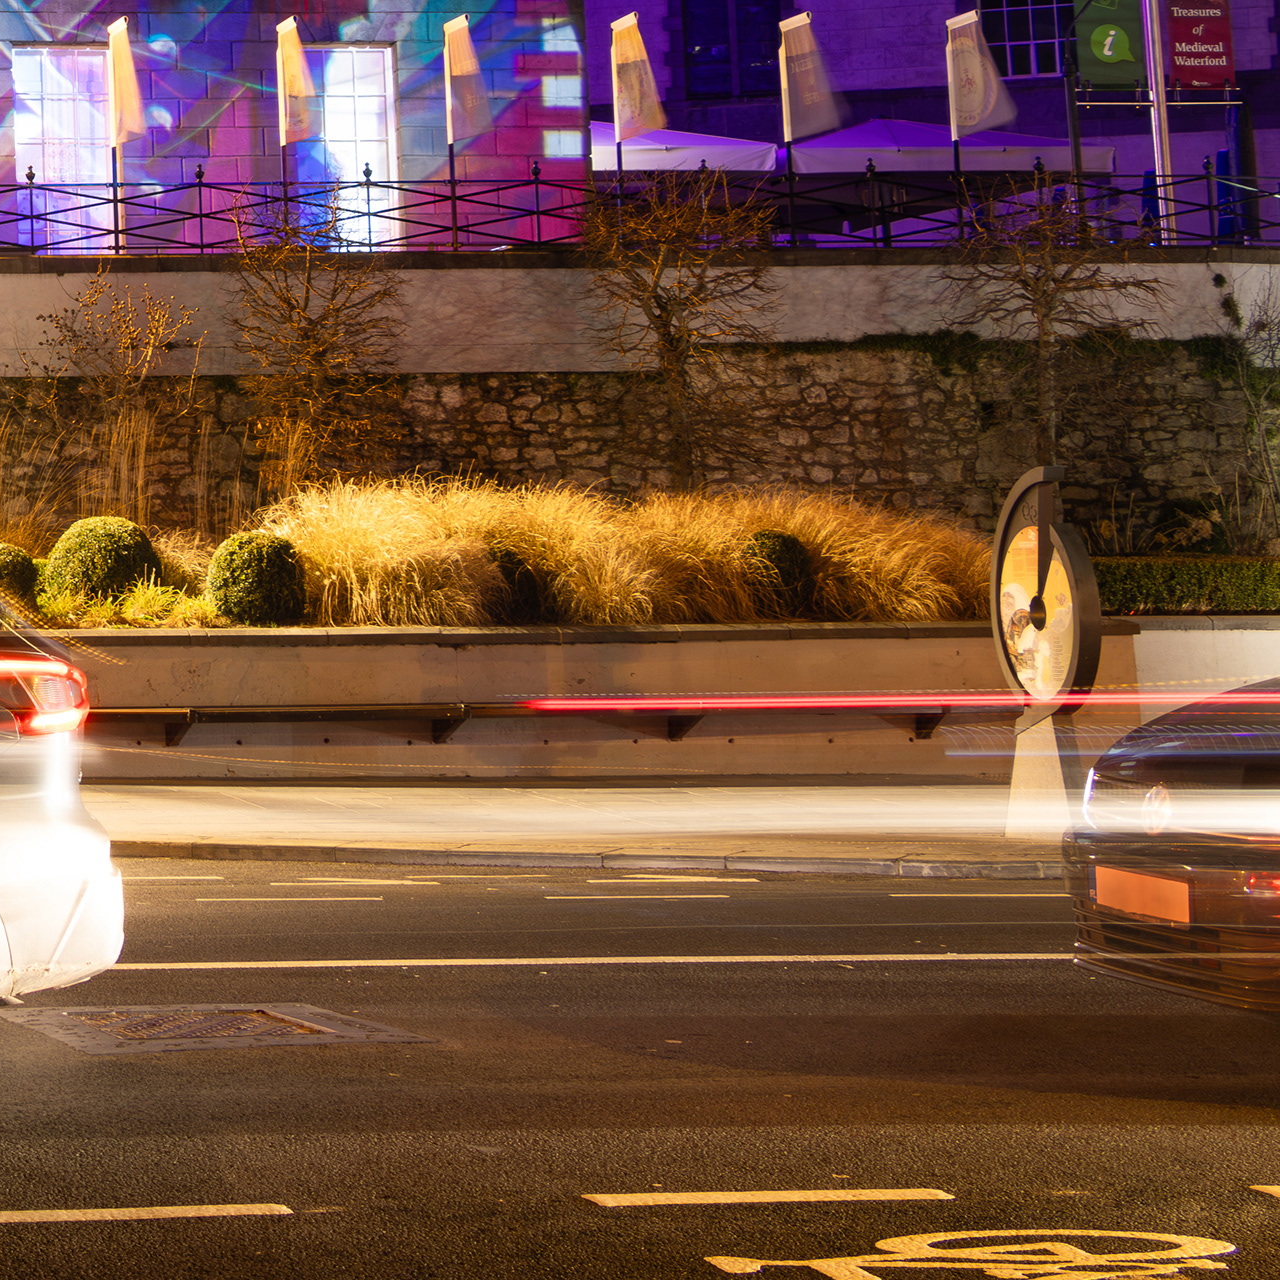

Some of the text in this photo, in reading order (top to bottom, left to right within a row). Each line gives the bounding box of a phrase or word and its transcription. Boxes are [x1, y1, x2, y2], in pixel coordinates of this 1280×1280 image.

[1171, 7, 1221, 17] Treasures
[1192, 24, 1205, 37] of
[1175, 42, 1224, 52] Medieval
[1174, 55, 1227, 66] Waterford
